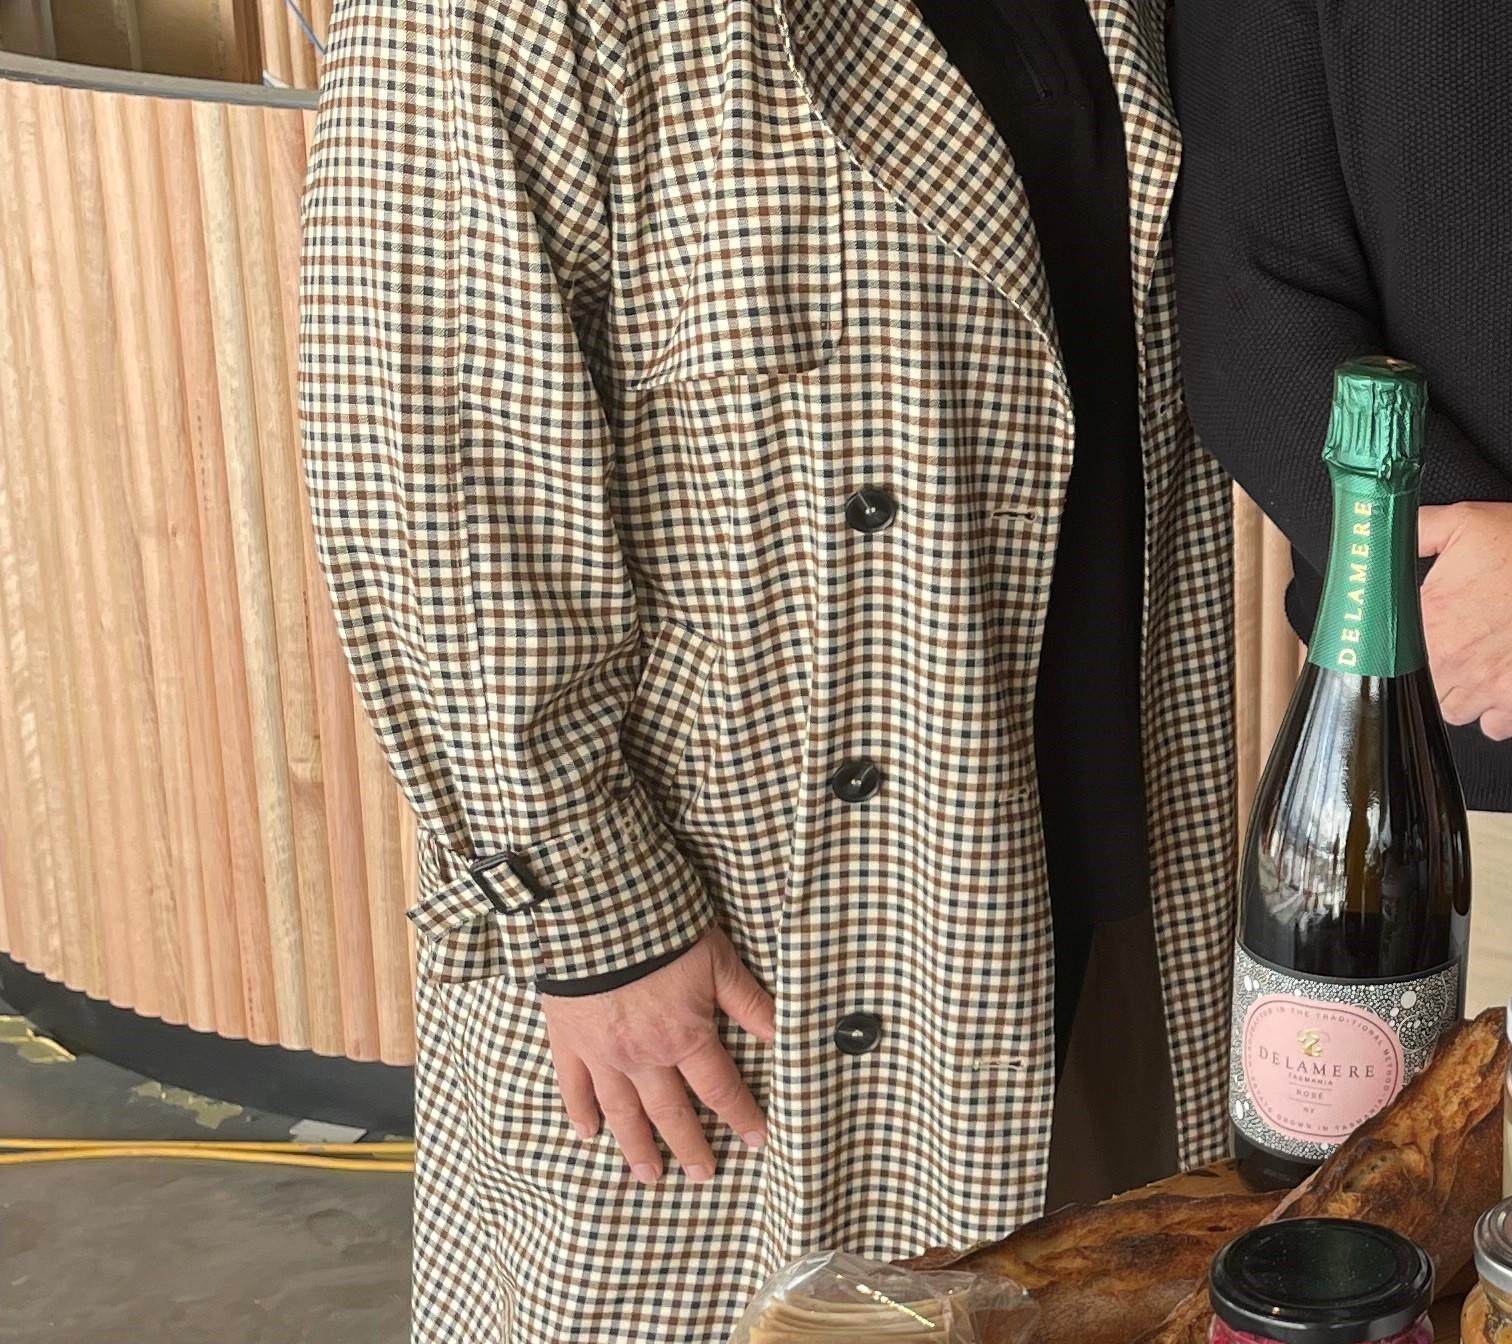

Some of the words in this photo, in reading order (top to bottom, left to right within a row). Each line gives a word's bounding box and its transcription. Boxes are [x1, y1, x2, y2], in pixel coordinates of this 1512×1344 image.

[1337, 501, 1372, 667] DELAMERE
[1258, 1045, 1376, 1078] DELAMERE
[1288, 1073, 1333, 1086] TASMANIA
